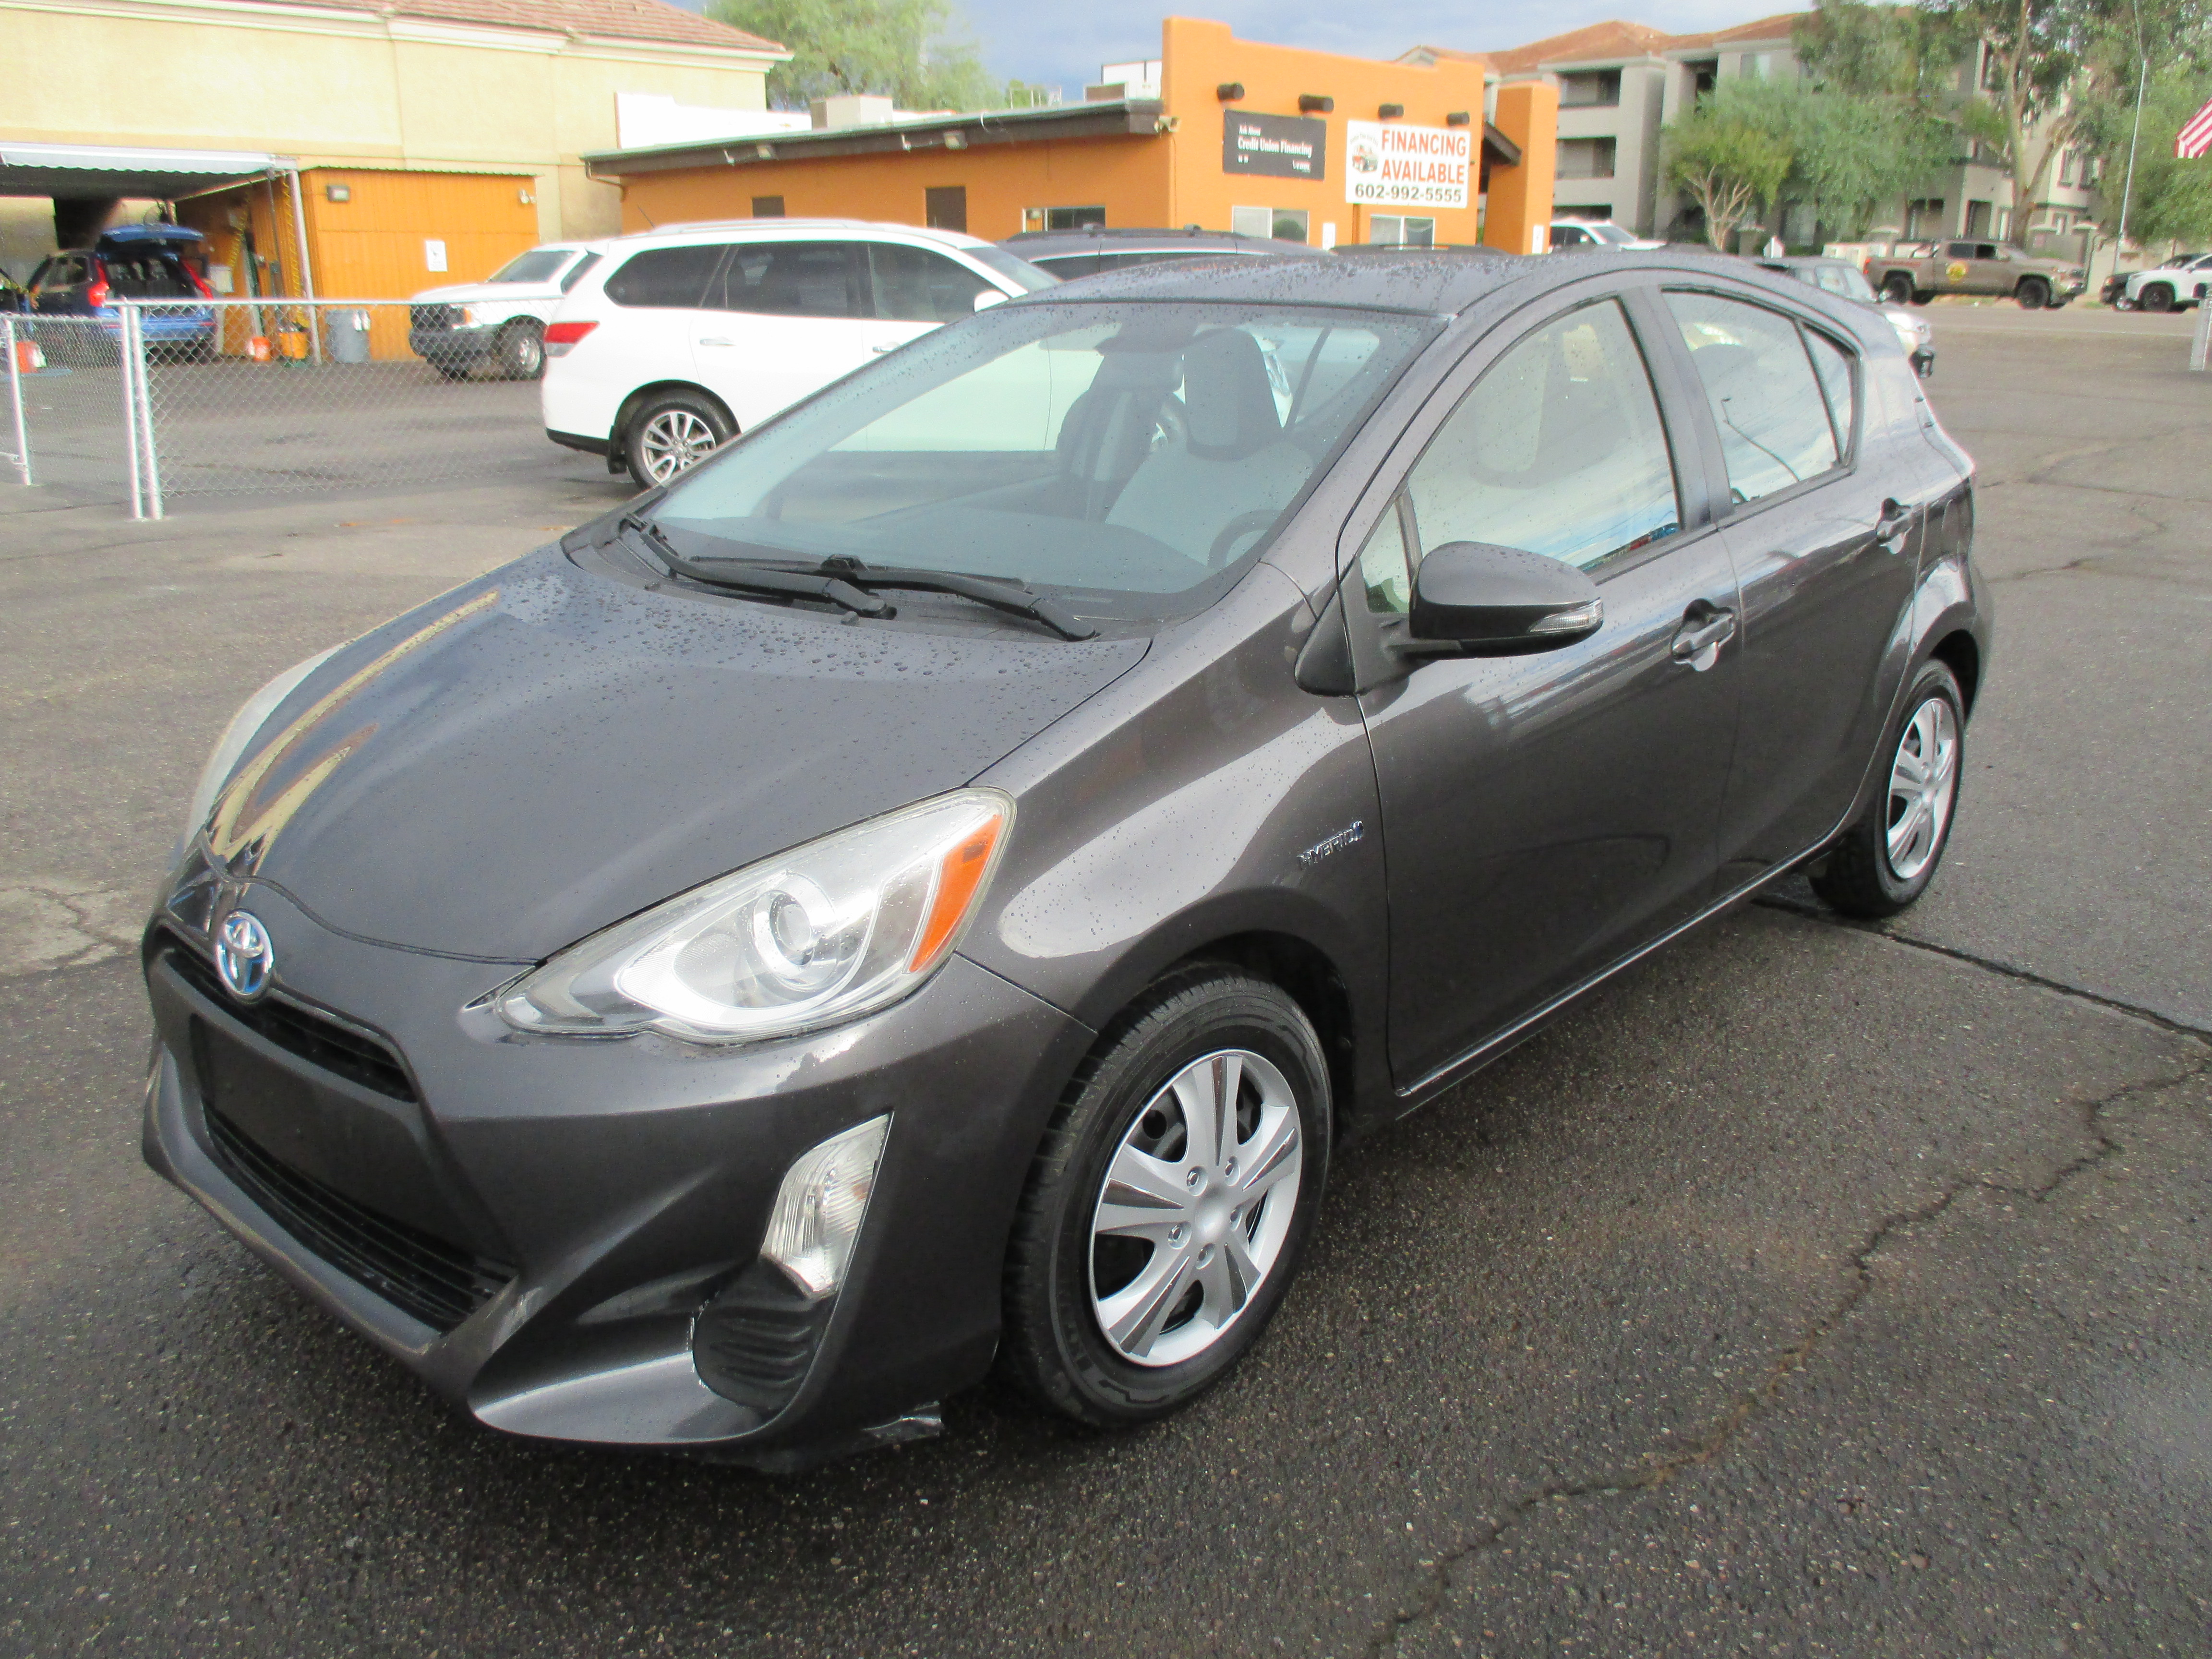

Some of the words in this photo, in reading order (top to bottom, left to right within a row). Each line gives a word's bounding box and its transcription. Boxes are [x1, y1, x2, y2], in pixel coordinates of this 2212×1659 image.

[1238, 135, 1259, 151] Credit
[1260, 137, 1280, 153] Union
[1280, 139, 1313, 159] Financing
[1382, 129, 1466, 156] FINANCING
[1381, 158, 1465, 184] AVAILABLE
[1355, 183, 1462, 202] 602-992-5555
[1297, 820, 1364, 870] HYBRID
